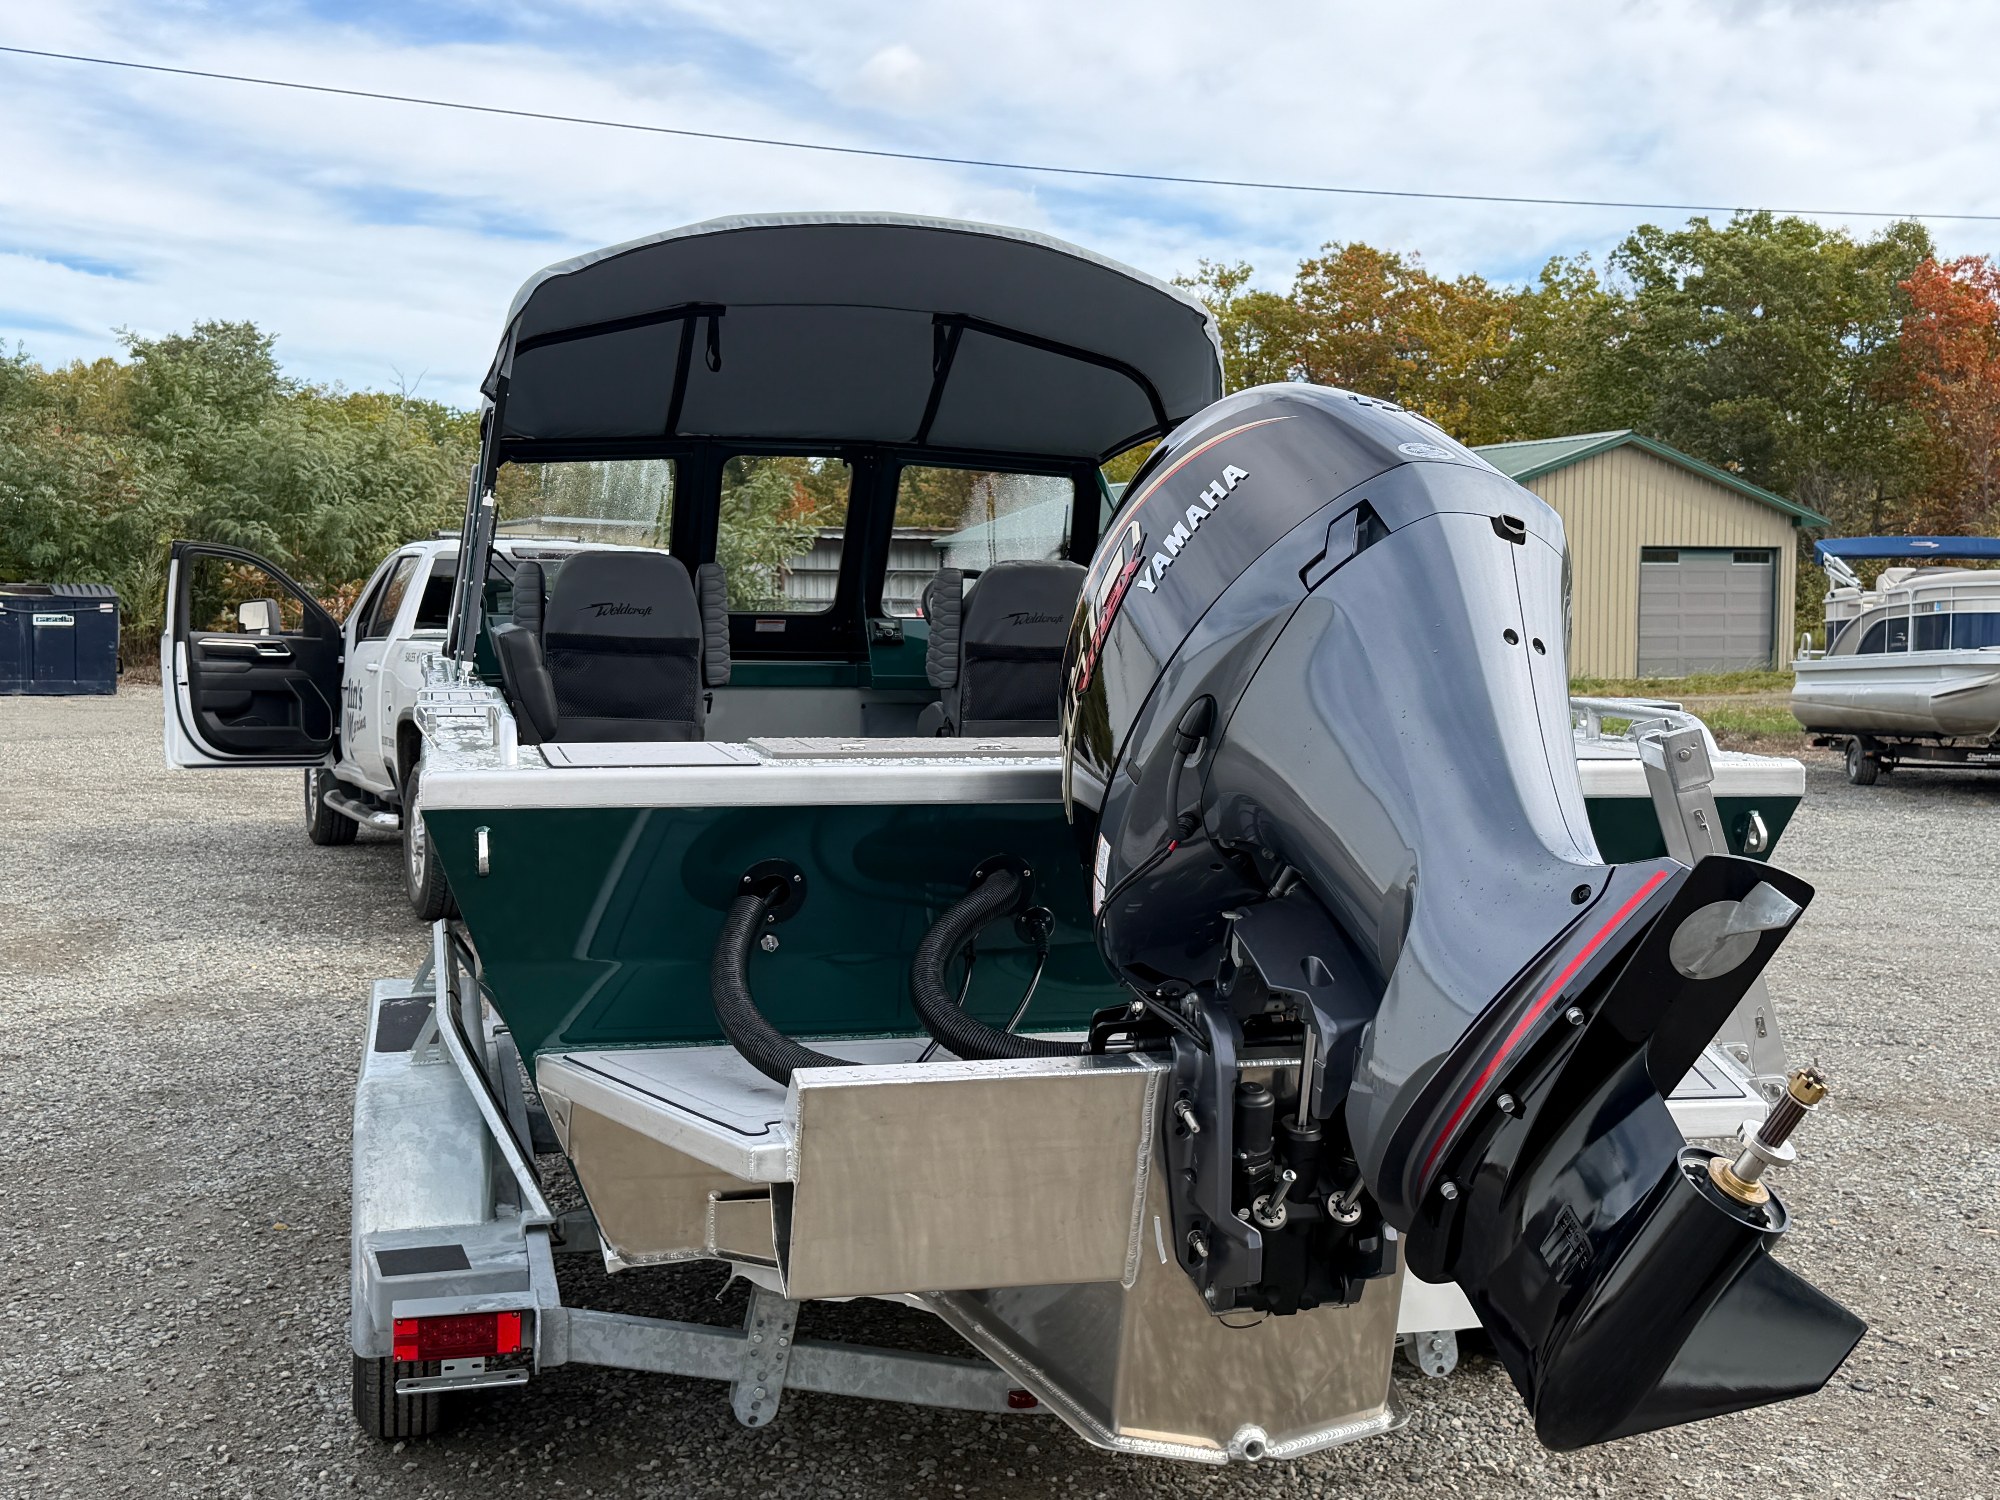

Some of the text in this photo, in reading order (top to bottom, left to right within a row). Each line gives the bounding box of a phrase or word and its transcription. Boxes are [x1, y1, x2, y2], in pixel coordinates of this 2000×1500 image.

[1137, 464, 1249, 594] YAMAHA
[580, 602, 653, 618] Weldcraft
[1001, 612, 1064, 627] Weldcraft
